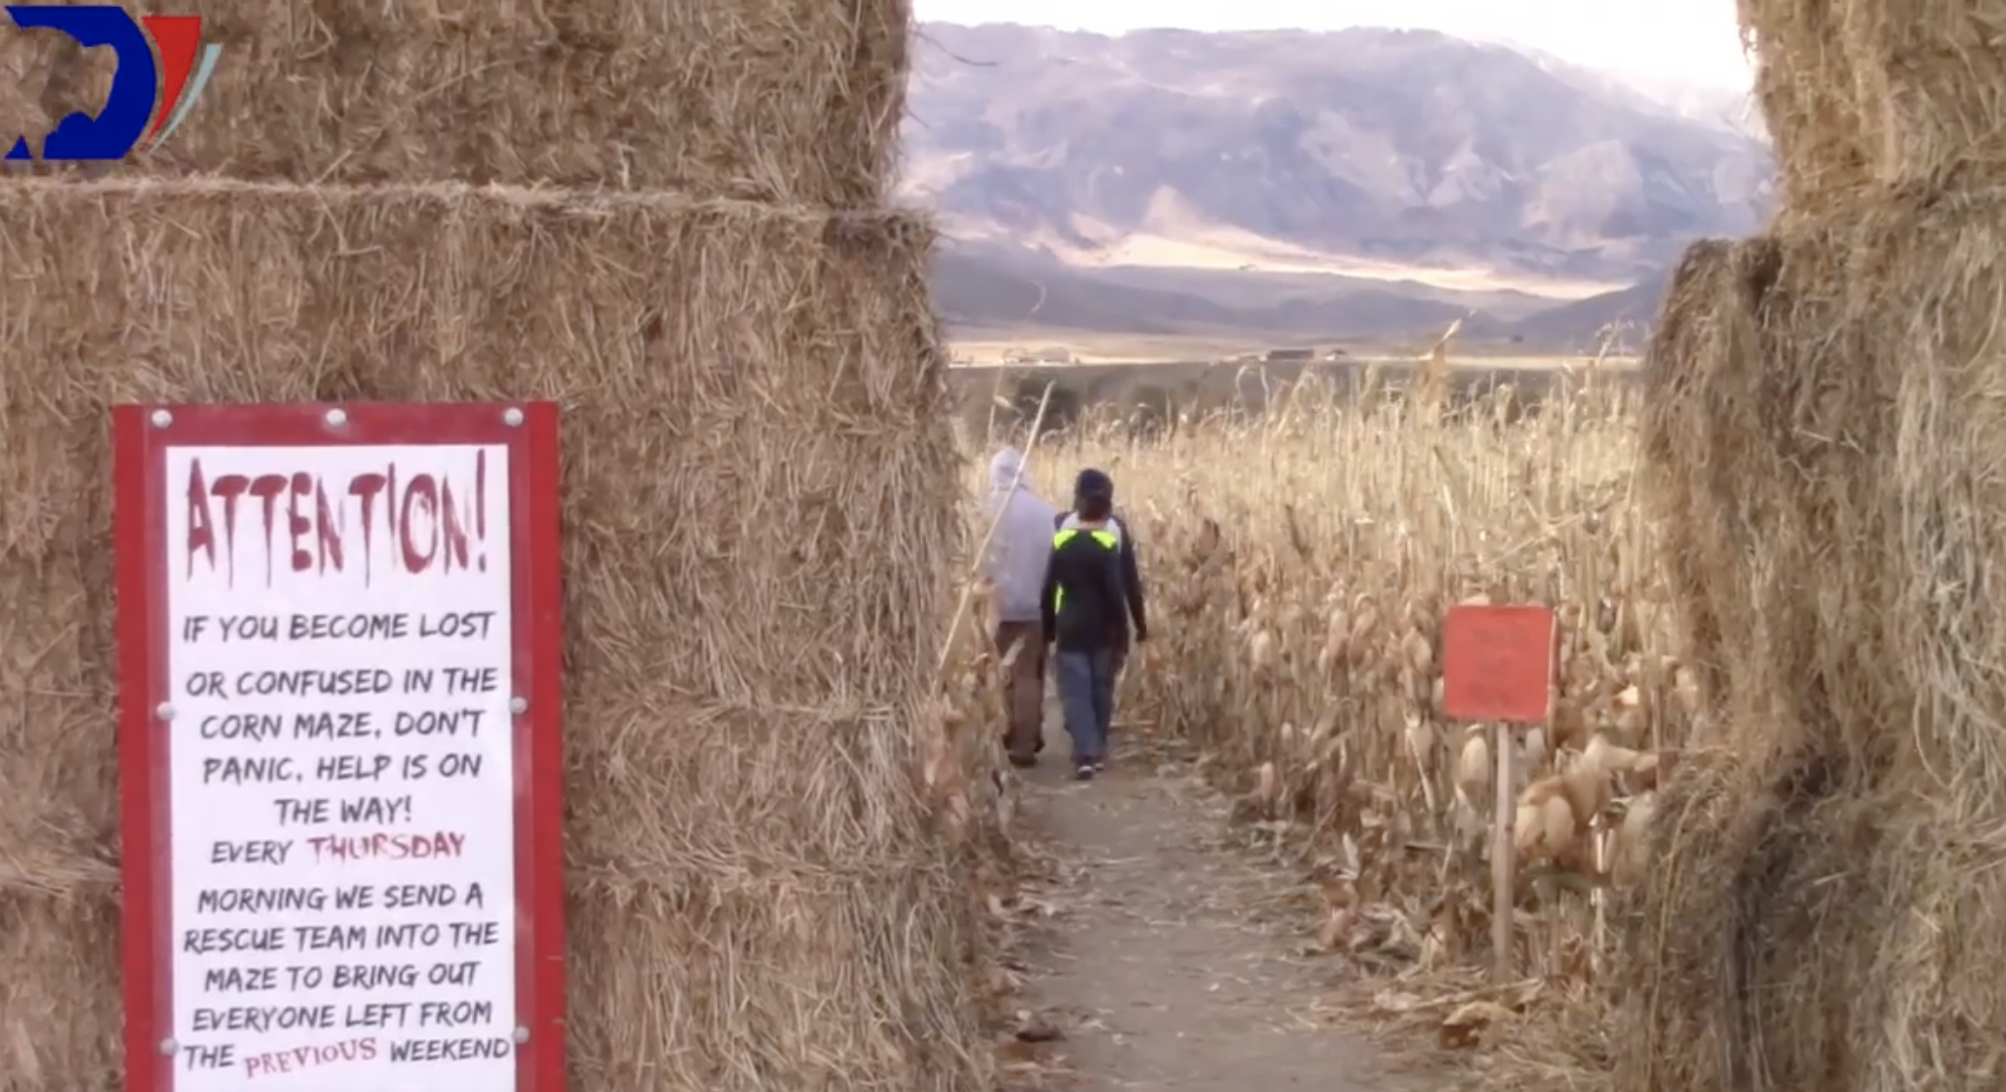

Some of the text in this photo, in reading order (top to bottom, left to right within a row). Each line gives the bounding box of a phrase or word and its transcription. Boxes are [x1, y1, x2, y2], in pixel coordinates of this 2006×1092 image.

[186, 448, 486, 589] ATTENTION!
[182, 610, 497, 644] IF YOU BECOME LOST
[184, 666, 499, 701] OR CONFUSED IN THE
[200, 714, 283, 743] CORN
[393, 707, 487, 738] DON'T
[315, 753, 393, 782] HELP
[401, 753, 429, 781] IS
[436, 752, 483, 779] ON
[273, 794, 412, 827] THE WAY!
[210, 830, 466, 866] EVERY THURSDAY
[196, 881, 484, 915] MORNING WE SEND A
[182, 921, 499, 956] RESCUE TEAM INTO THE
[203, 960, 482, 994] MAZE TO BRING OUT
[191, 1000, 493, 1034] EVERYONE LEFT FROM
[181, 1037, 509, 1078] THE PREVIOUS WEEKEND
